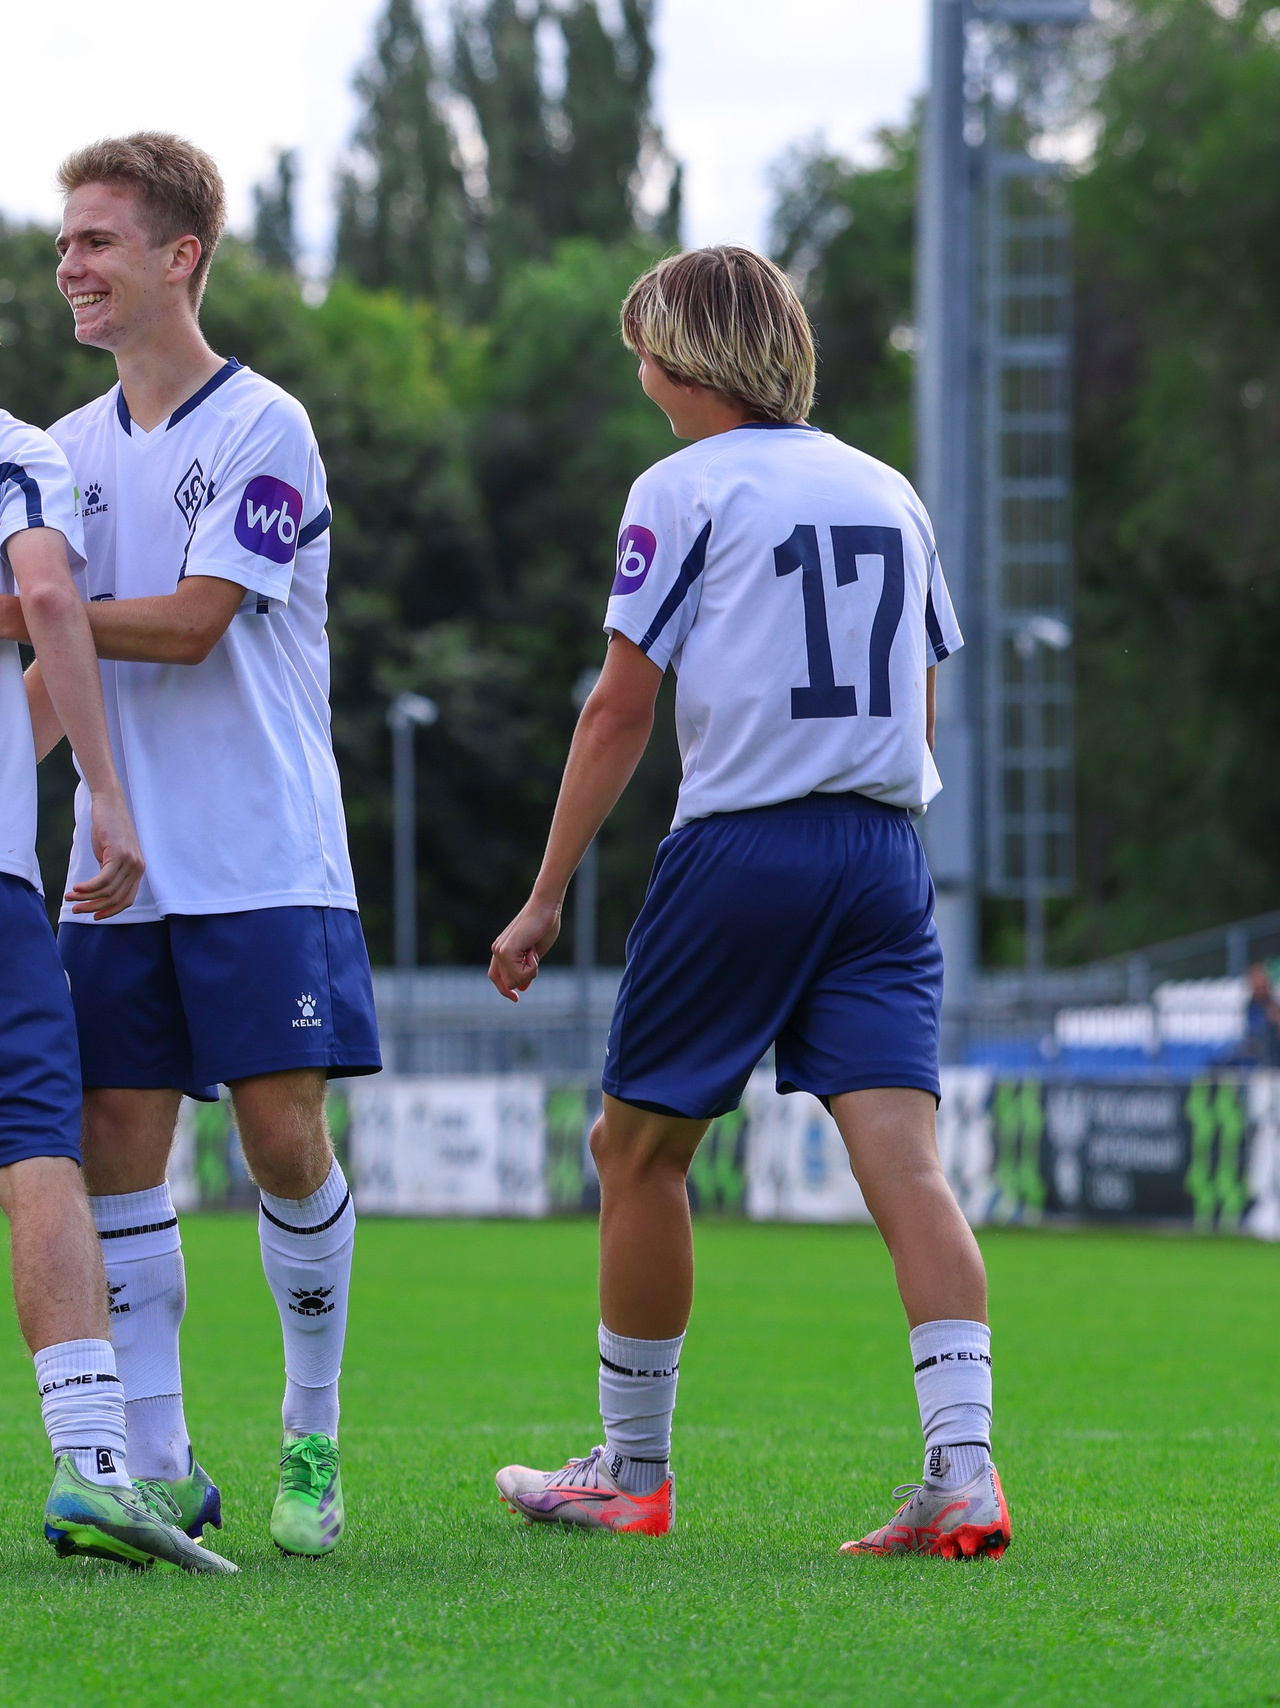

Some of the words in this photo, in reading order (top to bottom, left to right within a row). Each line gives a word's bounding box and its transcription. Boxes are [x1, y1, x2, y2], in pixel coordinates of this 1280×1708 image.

[246, 498, 296, 545] wb
[773, 524, 905, 720] 17
[292, 1018, 322, 1028] KELME
[288, 1302, 336, 1316] KELME
[610, 1452, 624, 1483] SIGN
[930, 1445, 943, 1479] SIGN
